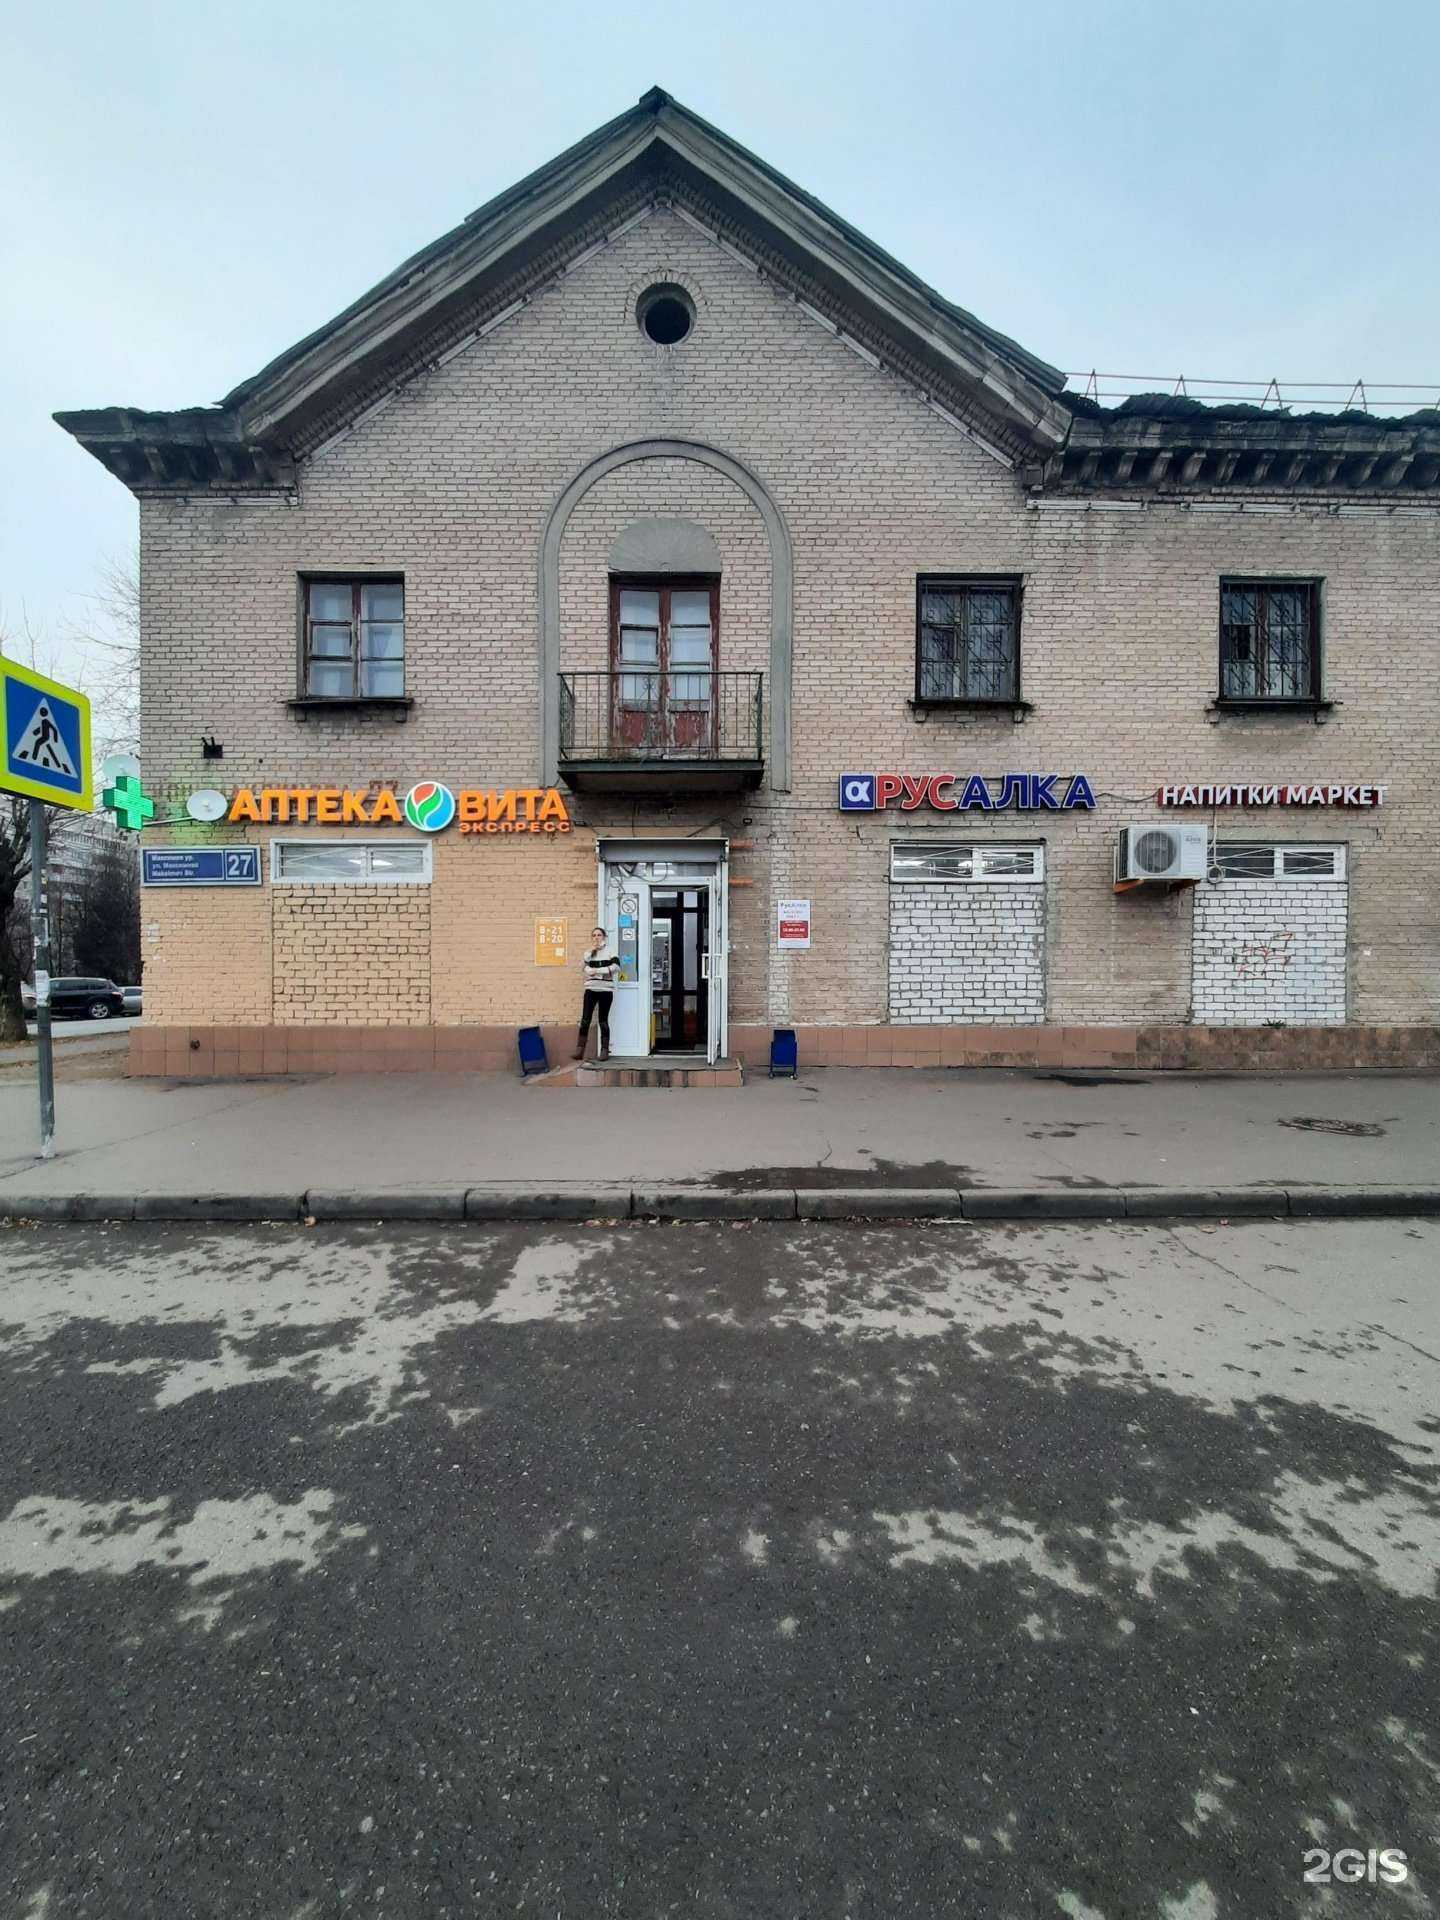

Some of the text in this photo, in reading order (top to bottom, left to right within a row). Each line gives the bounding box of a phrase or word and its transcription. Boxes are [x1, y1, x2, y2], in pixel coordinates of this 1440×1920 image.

[875, 774, 1097, 810] РУСАЛКА
[1161, 784, 1389, 806] НАПИТКИ МАРКЕТ
[228, 788, 569, 822] АПТЕКА ВИТА
[459, 821, 571, 833] ЭКСПРЕСС
[228, 854, 252, 876] 27
